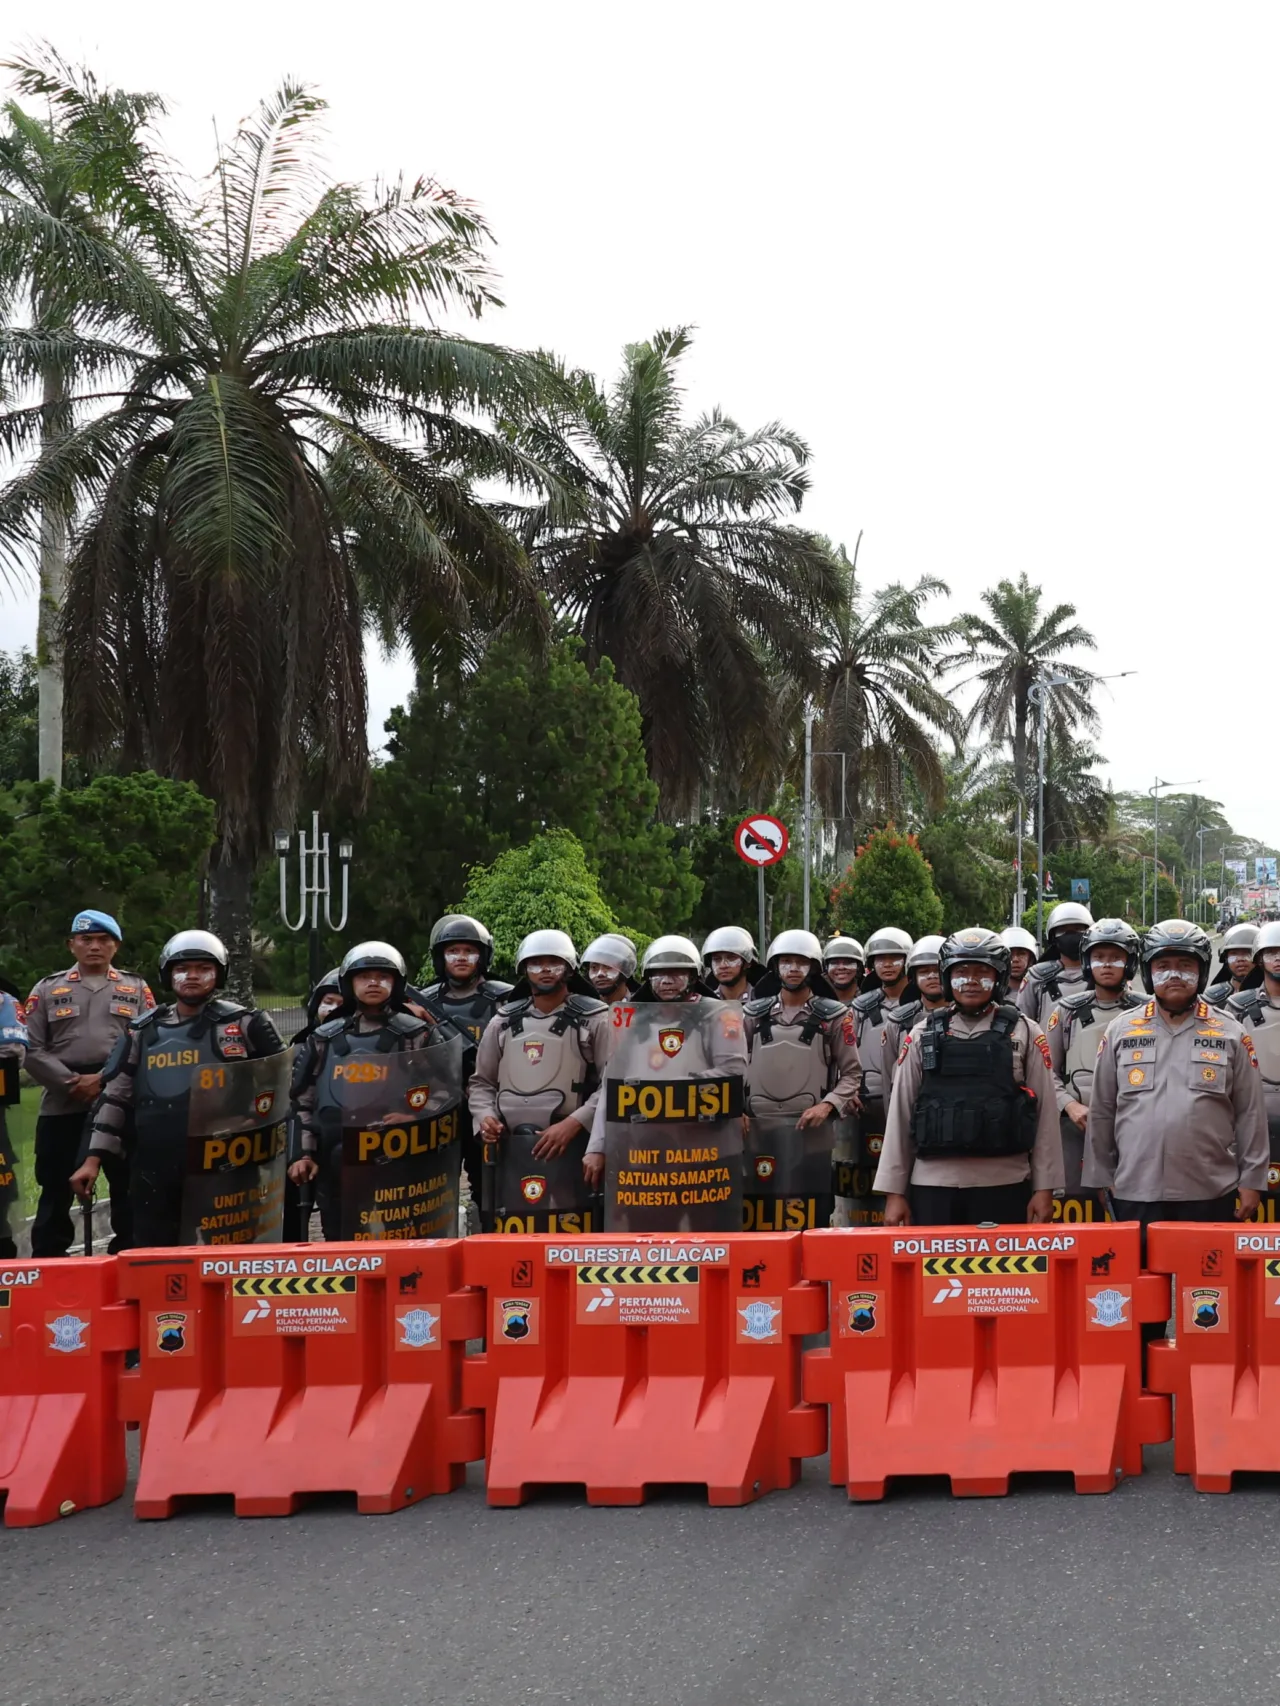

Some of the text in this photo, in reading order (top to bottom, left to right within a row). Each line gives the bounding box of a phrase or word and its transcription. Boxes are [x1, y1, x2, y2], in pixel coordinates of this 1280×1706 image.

[112, 994, 138, 1006] POLRI
[613, 1007, 636, 1028] 37
[1122, 1038, 1156, 1049] BUDI ADHY
[1194, 1038, 1226, 1050] POLRI
[148, 1049, 200, 1071] POLISI
[200, 1068, 226, 1090] 81
[618, 1082, 730, 1118] POLISI
[358, 1108, 458, 1161] POLISI
[629, 1147, 719, 1164] UNIT DALMAS
[618, 1167, 730, 1186] SATUAN SAMAPTA
[375, 1173, 447, 1203] UNIT DALMAS
[617, 1186, 732, 1206] POLRESTA CILACAP
[200, 1210, 250, 1231] SATUAN
[360, 1207, 410, 1225] SATUAN
[893, 1236, 1075, 1255] POLRESTA CILACAP
[547, 1247, 726, 1263] POLRESTA CILACAP
[202, 1256, 383, 1275] POLRESTA CILACAP
[967, 1287, 1031, 1297] PERTAMINA
[619, 1296, 682, 1307] PERTAMINA
[967, 1297, 1039, 1306] KILANG PERTAMINA
[967, 1305, 1028, 1313] INTERNASIONAL
[275, 1307, 339, 1318] PERTAMINA
[619, 1307, 690, 1315] KILANG PERTAMINA
[619, 1315, 679, 1323] INTERNASIONAL
[276, 1317, 348, 1326] KILANG PERTAMINA
[276, 1325, 337, 1333] INTERNASIONAL
